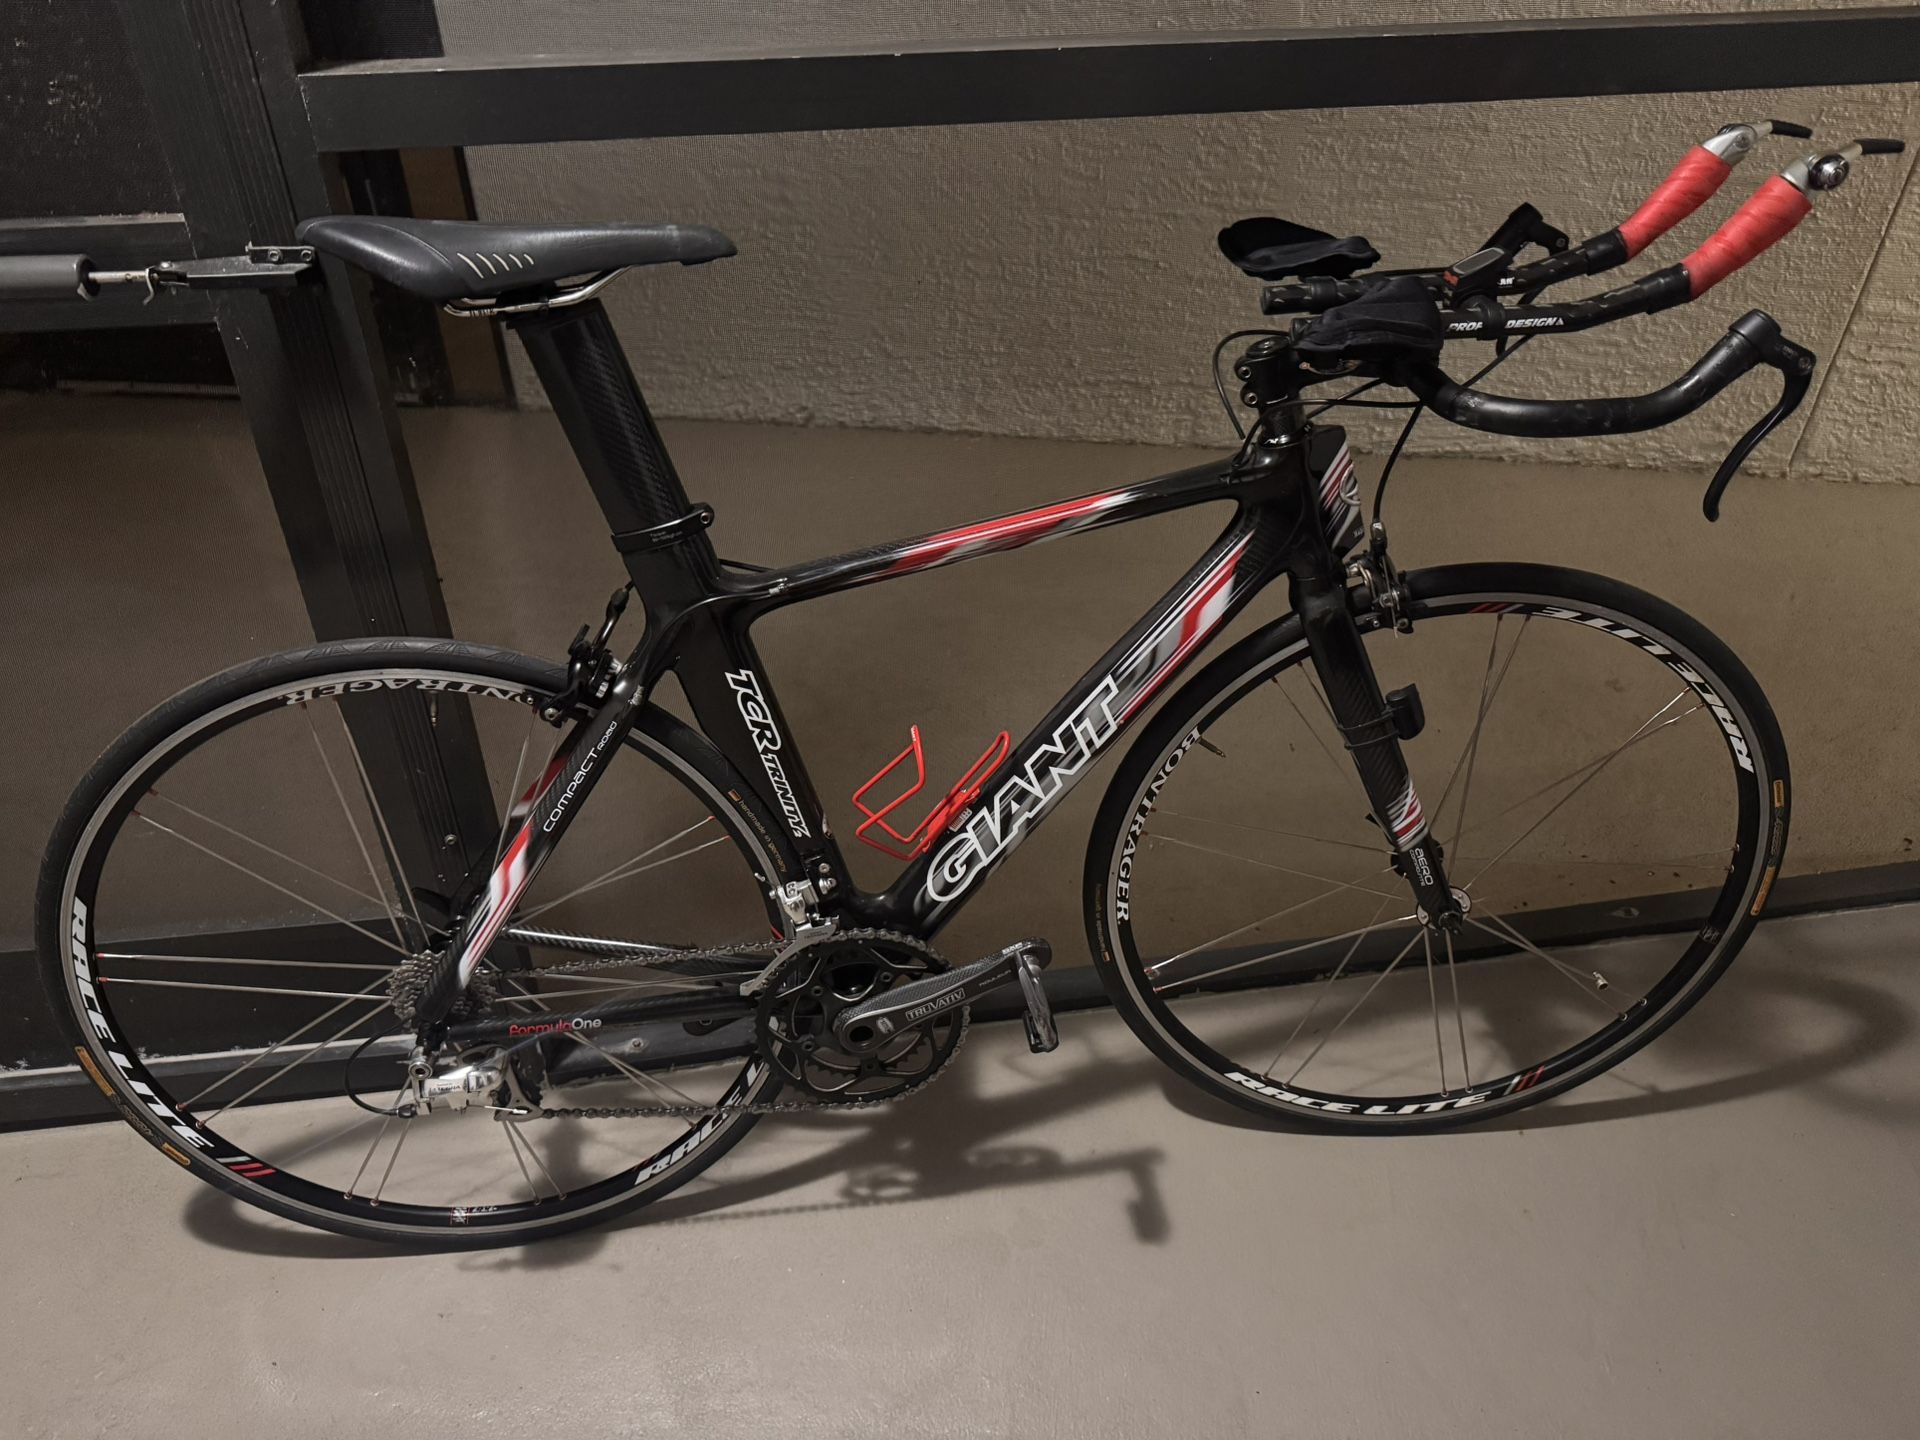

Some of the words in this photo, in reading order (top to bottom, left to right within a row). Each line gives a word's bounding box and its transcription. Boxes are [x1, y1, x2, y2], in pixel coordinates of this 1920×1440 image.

[1505, 317, 1557, 329] DESIGN
[1532, 606, 1672, 655] LITE
[1667, 661, 1755, 774] RACE
[724, 668, 782, 754] TCR
[760, 753, 812, 839] TRINITY
[926, 674, 1120, 903] GIANT
[738, 800, 765, 834] handmade
[72, 896, 117, 1043] RACE
[108, 1051, 215, 1148] LITE
[907, 990, 965, 1020] TRUVATIV
[1224, 1071, 1360, 1113] RACE
[1363, 1091, 1491, 1115] LITE
